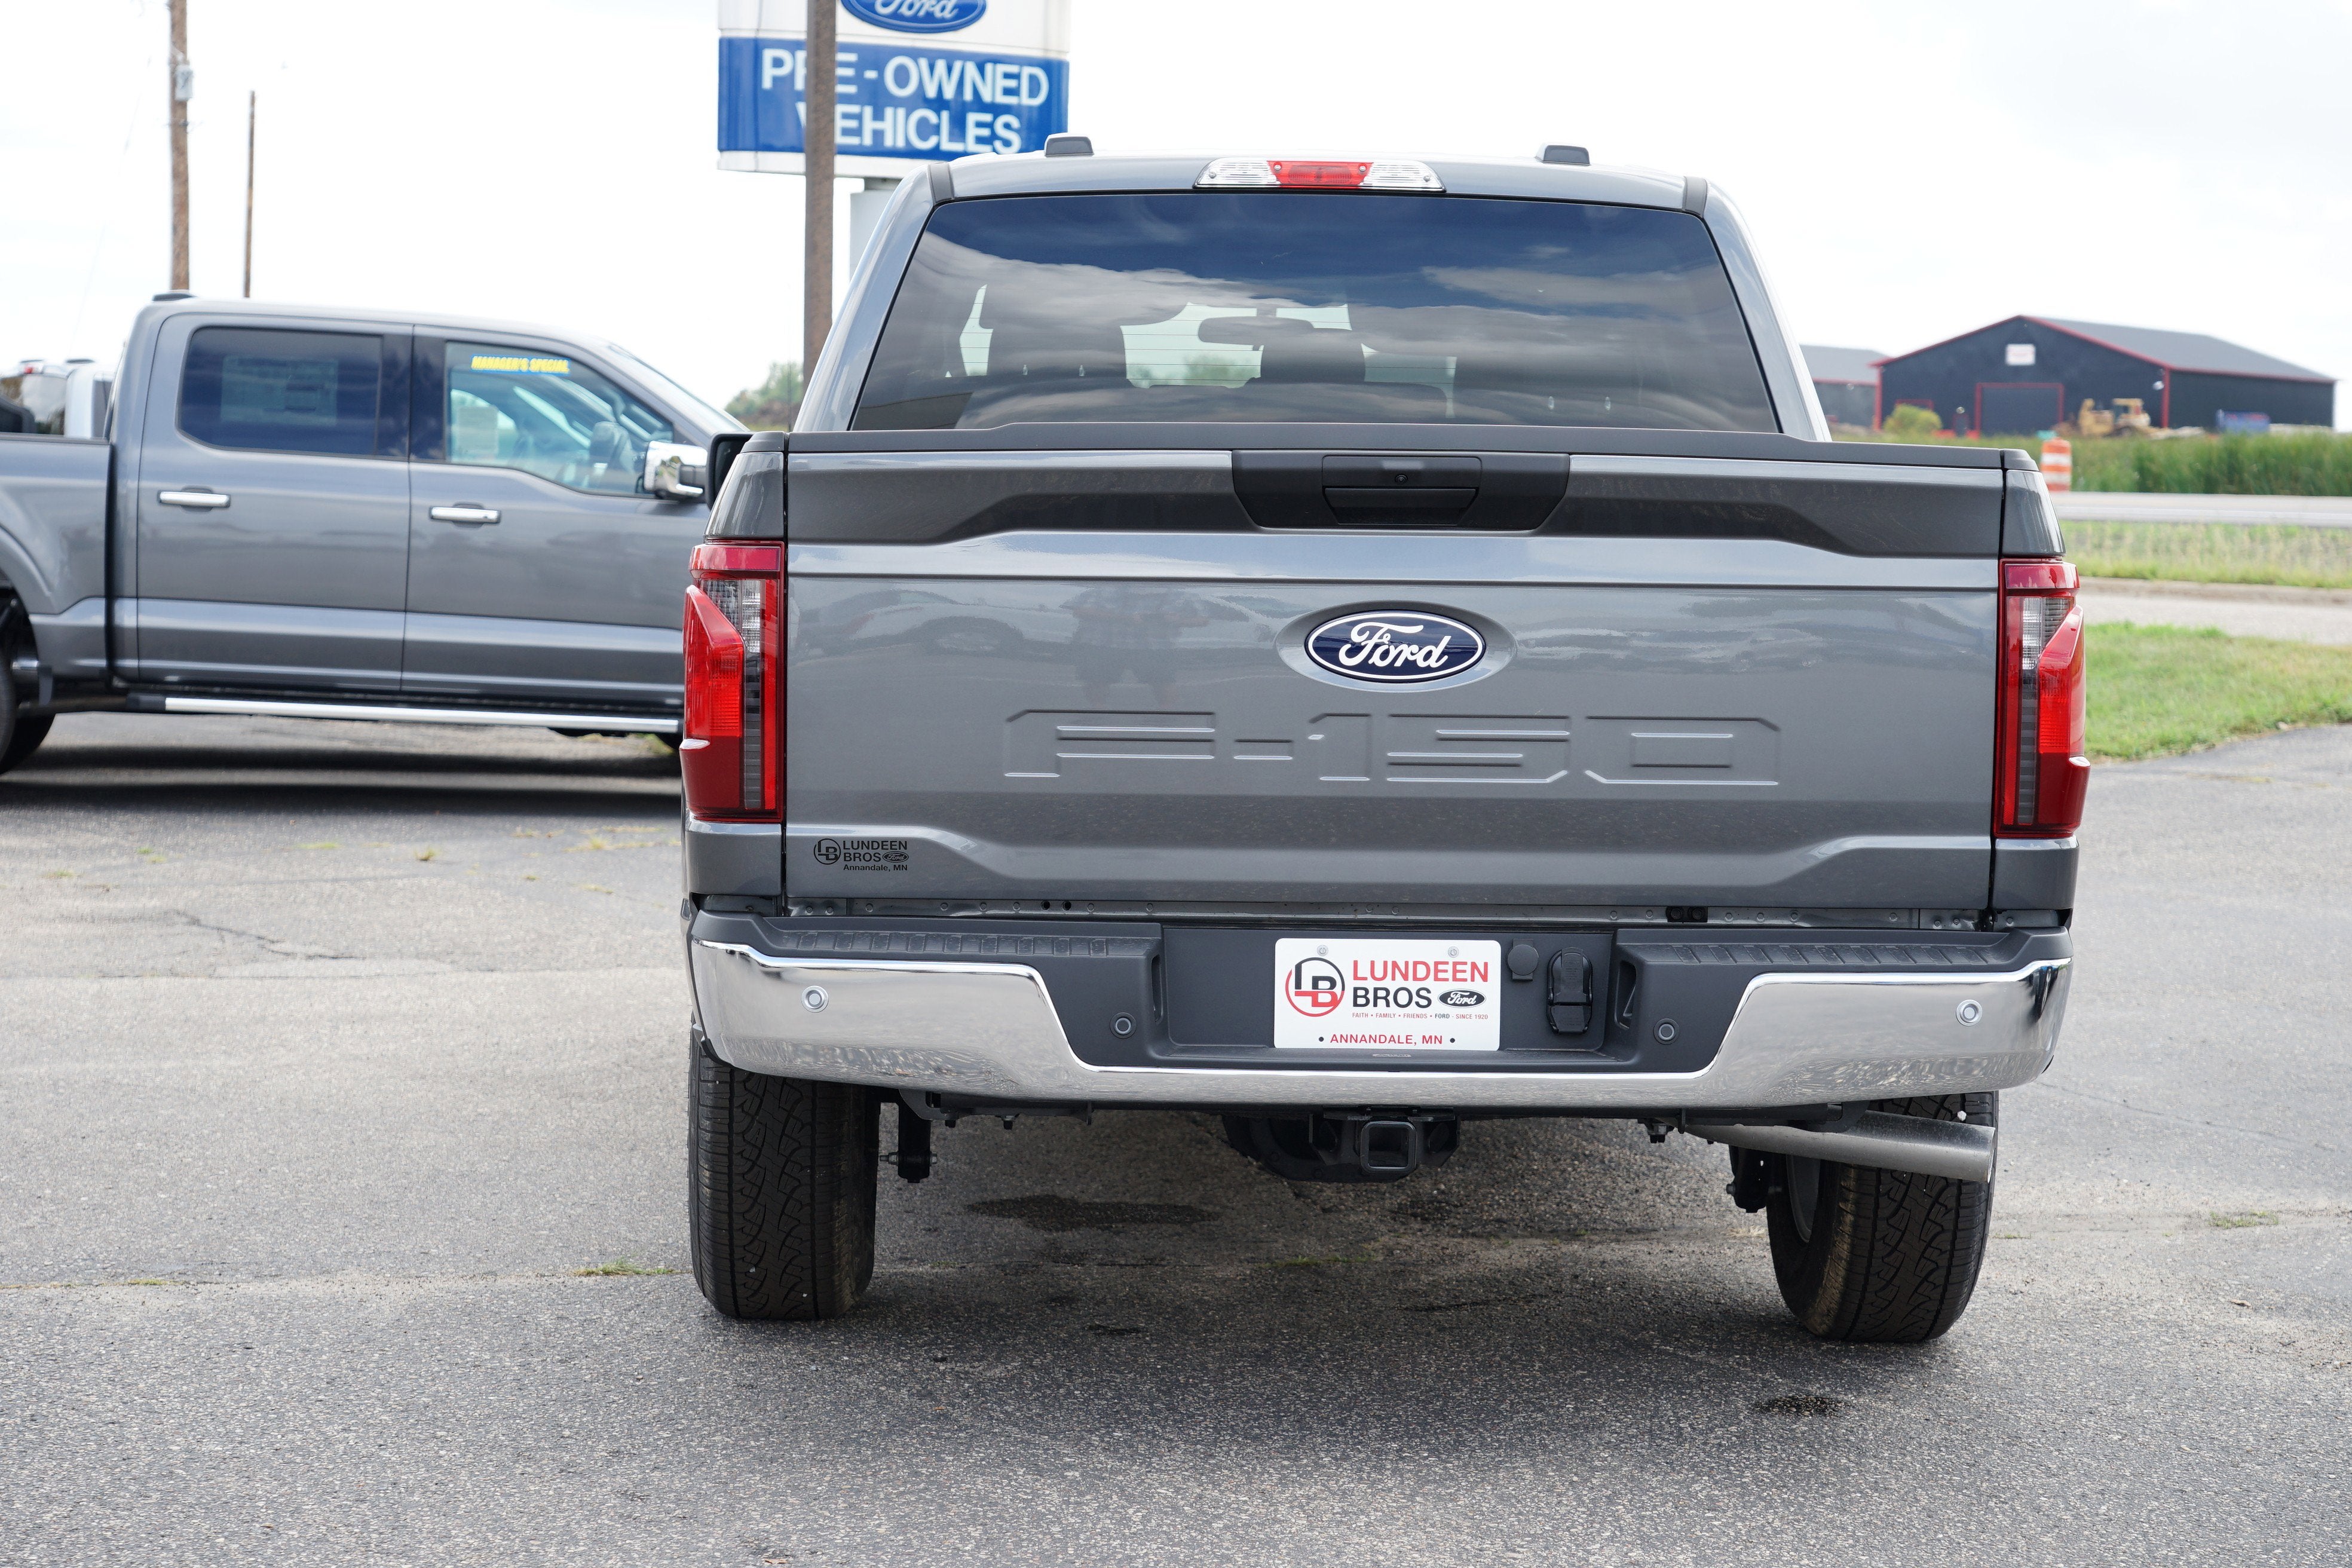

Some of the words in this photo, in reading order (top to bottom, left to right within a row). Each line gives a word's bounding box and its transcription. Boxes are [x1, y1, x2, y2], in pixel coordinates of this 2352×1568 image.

[1339, 621, 1452, 667] Ford
[1004, 708, 1781, 785] F-150
[843, 840, 907, 850] LUNDEEN
[843, 852, 881, 862] BROS
[1352, 960, 1489, 982] LUNDEEN
[1352, 987, 1432, 1009] BROS
[1447, 991, 1477, 1006] Ford
[1330, 1034, 1417, 1046] ANNANDALE,
[1422, 1034, 1443, 1045] MN
